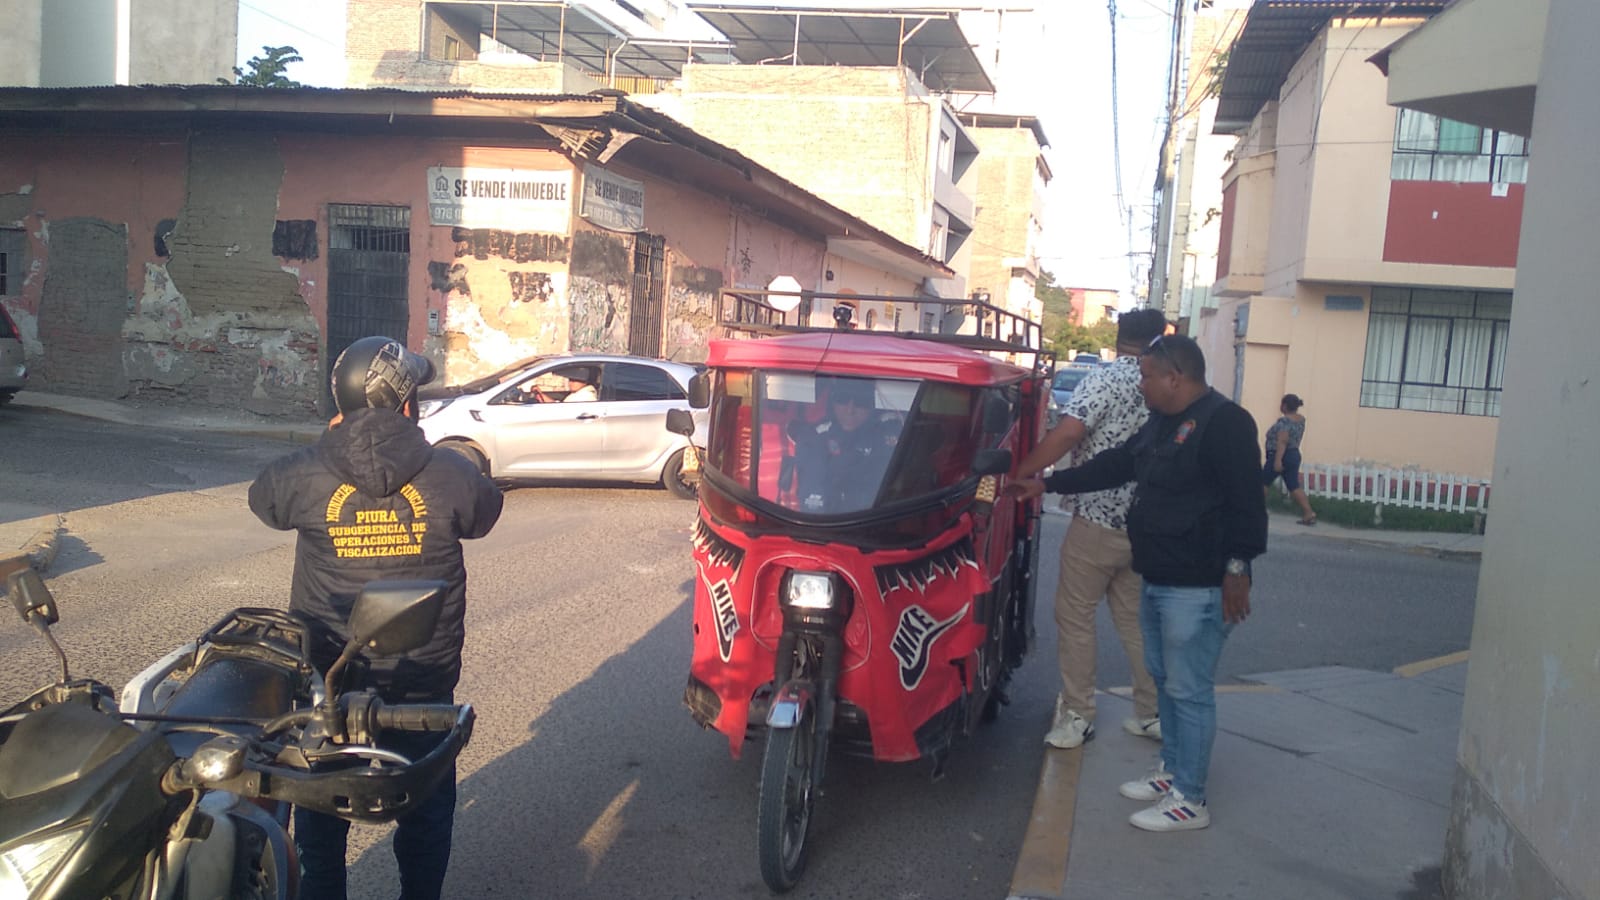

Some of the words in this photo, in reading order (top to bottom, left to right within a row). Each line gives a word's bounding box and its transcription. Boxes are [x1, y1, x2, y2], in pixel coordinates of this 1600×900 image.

[454, 179, 468, 198] SE
[471, 180, 506, 199] VENDE
[509, 181, 567, 201] INMUEBLE
[355, 509, 399, 524] PIURA
[327, 523, 408, 537] SUBGERENCIA
[411, 522, 427, 534] DE
[333, 533, 411, 548] OPERACIONES
[414, 533, 424, 544] Y
[336, 544, 423, 558] FISCALIZACION
[714, 582, 738, 636] NIKE
[892, 606, 936, 666] NIKE
